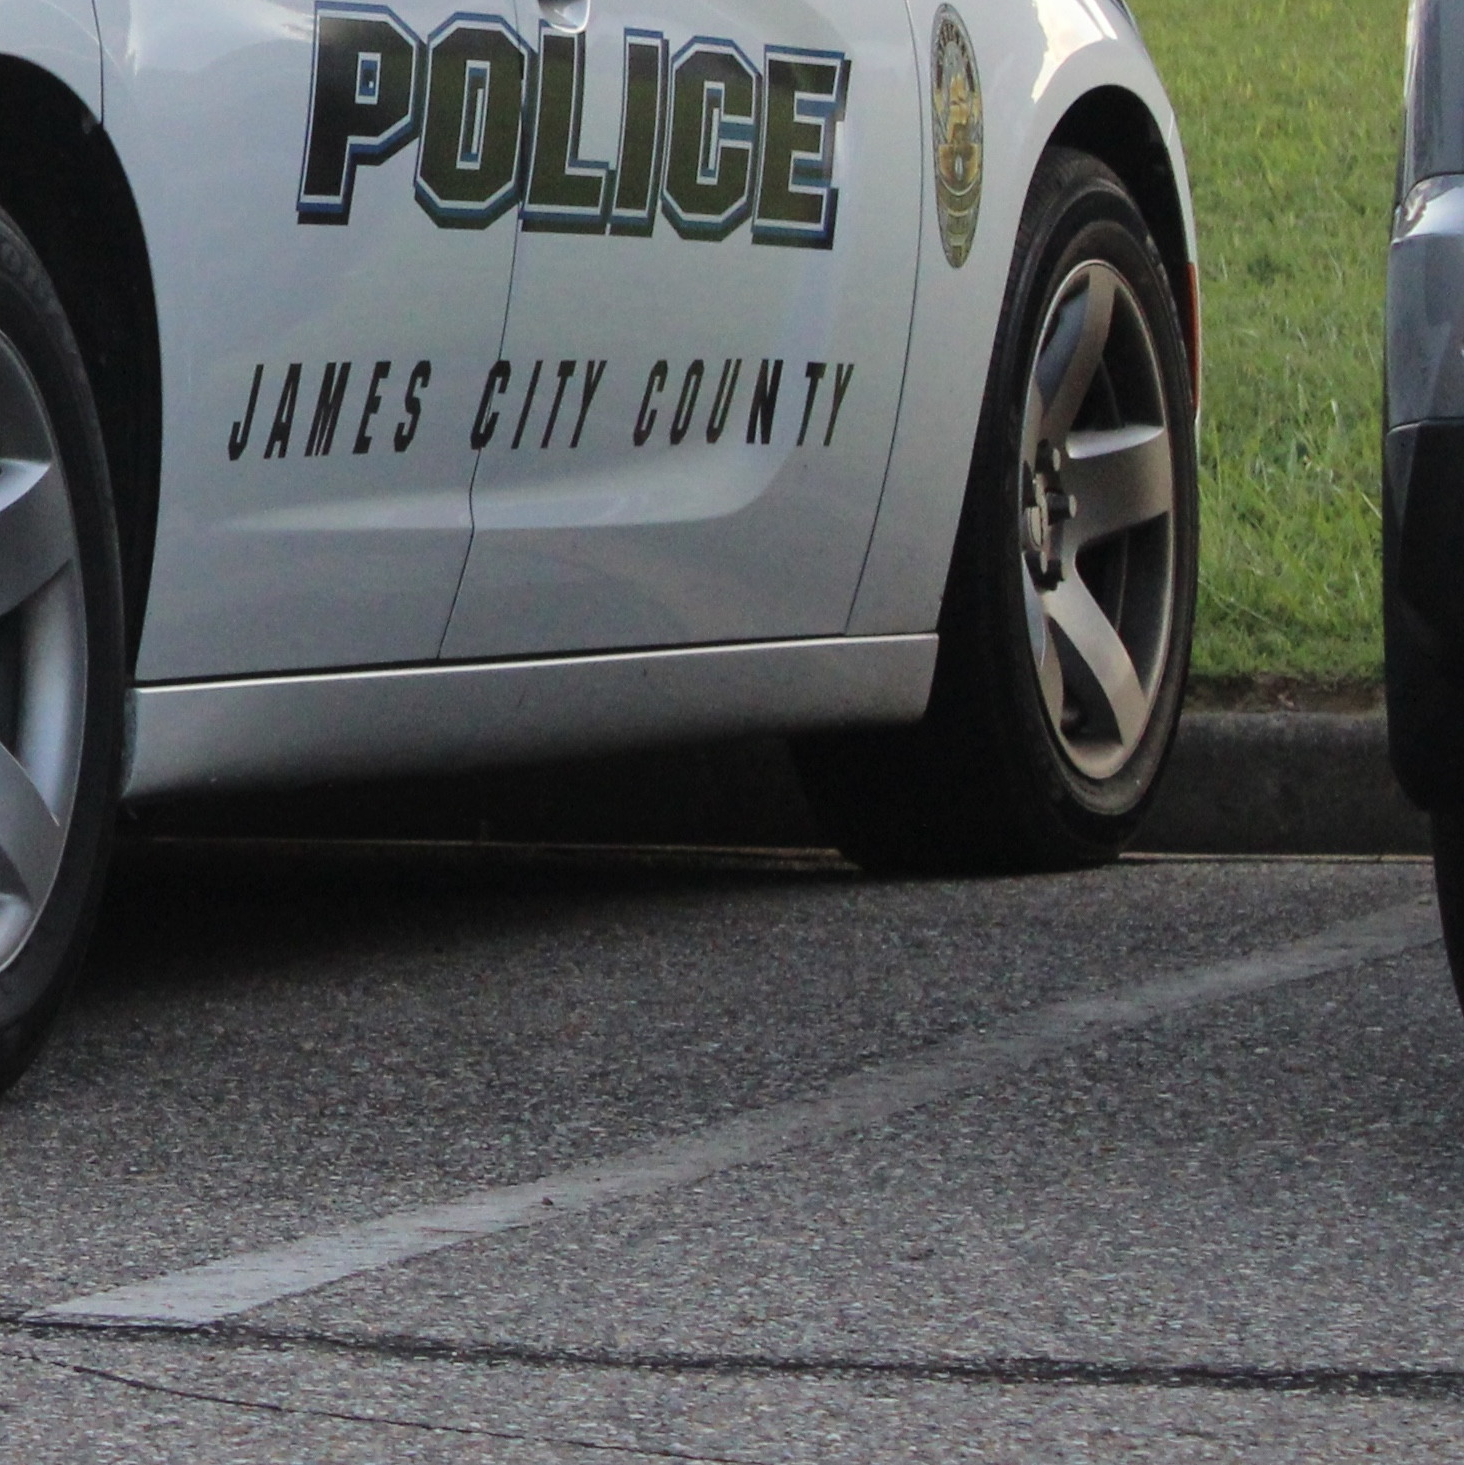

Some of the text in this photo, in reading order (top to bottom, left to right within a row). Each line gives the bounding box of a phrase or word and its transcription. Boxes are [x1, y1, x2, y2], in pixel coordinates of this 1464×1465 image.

[295, 0, 852, 250] POLICE
[227, 358, 855, 461] JAMES CITY COUNTY
